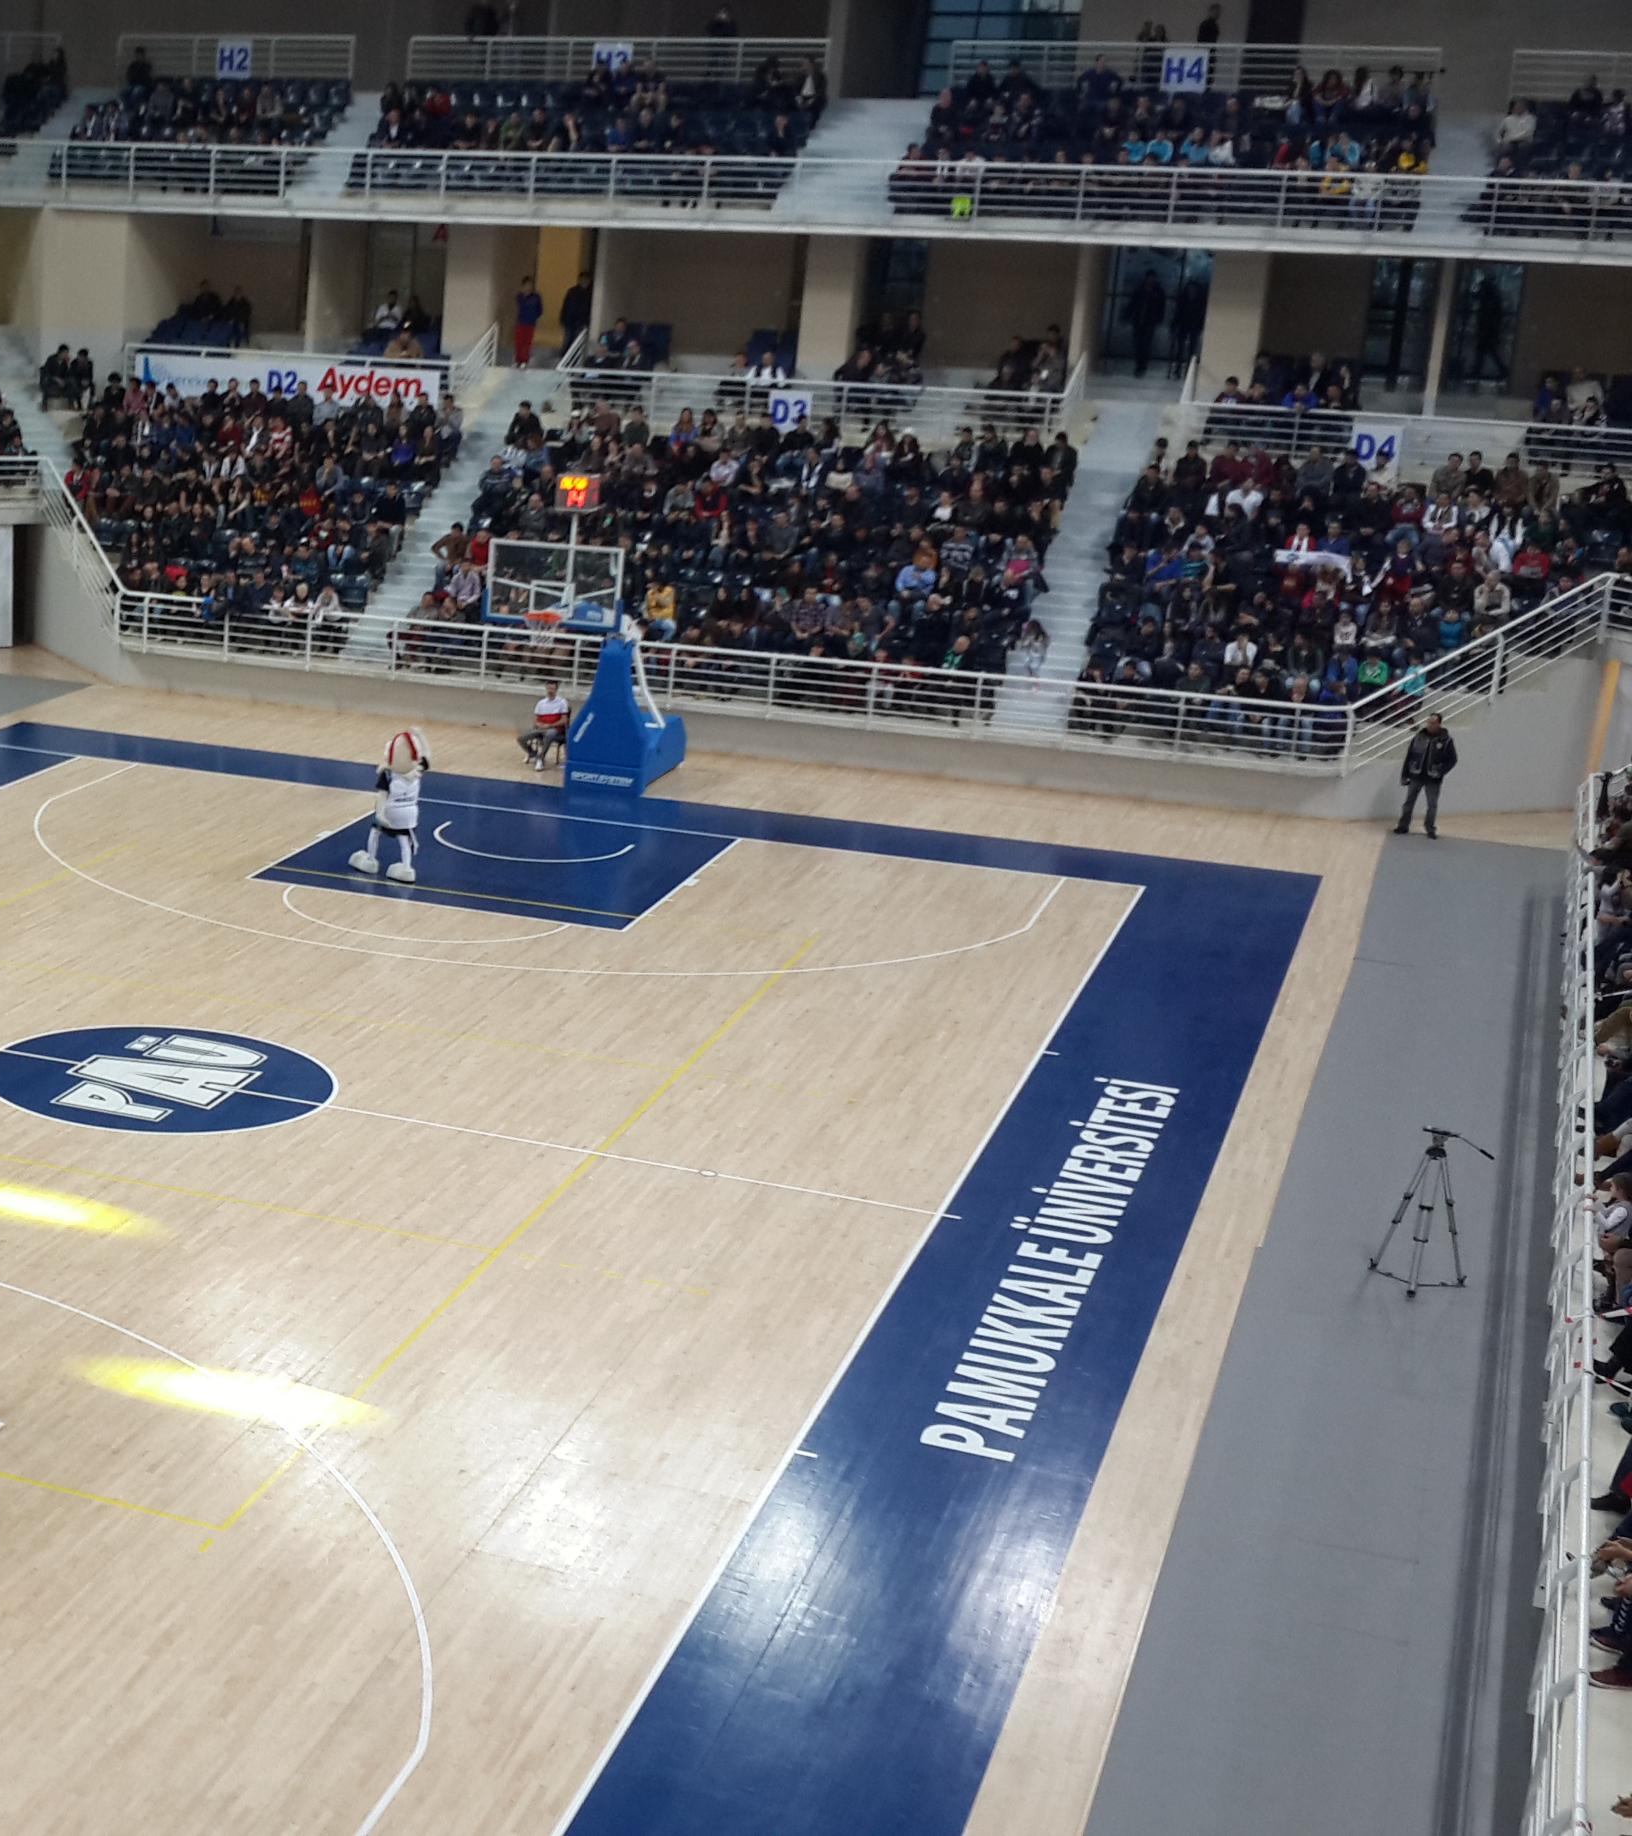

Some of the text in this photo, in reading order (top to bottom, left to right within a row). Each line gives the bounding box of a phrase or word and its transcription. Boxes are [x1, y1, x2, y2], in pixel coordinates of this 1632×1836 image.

[219, 47, 249, 71] H2
[1164, 56, 1202, 84] H4
[267, 369, 298, 395] D2
[317, 366, 424, 399] Aydem
[1356, 434, 1395, 461] D4
[49, 1034, 269, 1123] PAÜ
[920, 1076, 1180, 1463] PAMUKKALE ÜNİVERSİTESİ
